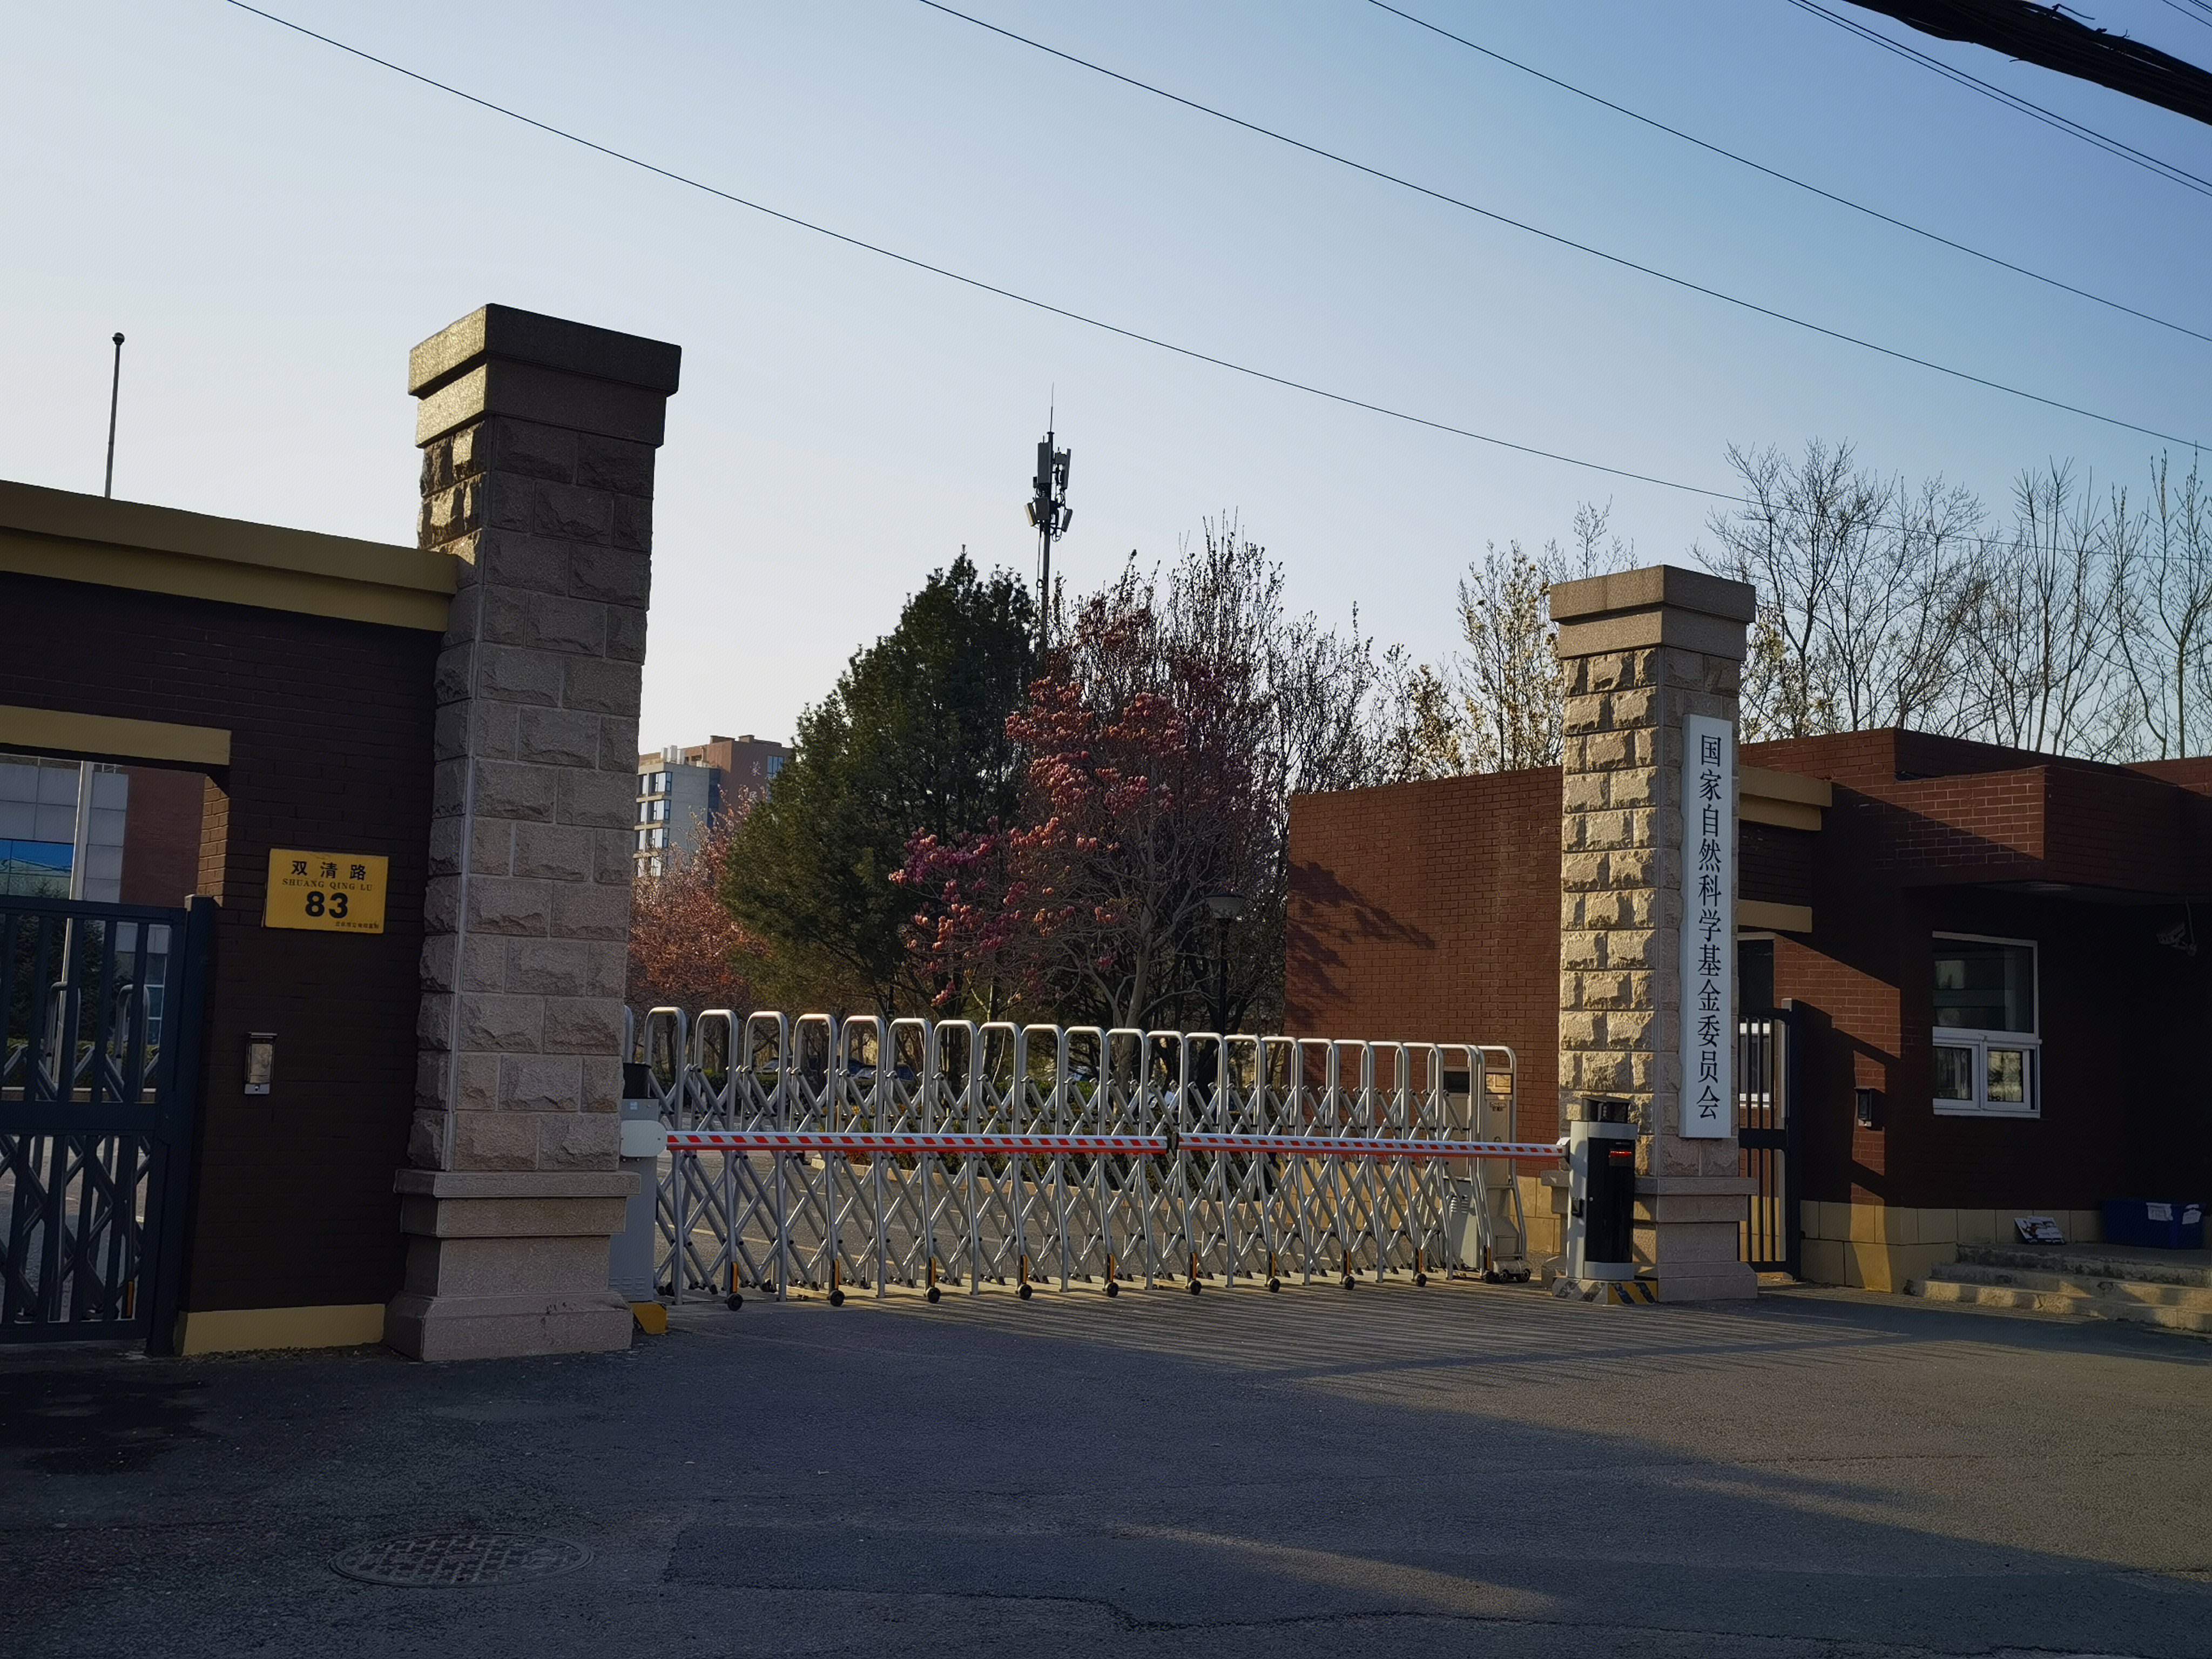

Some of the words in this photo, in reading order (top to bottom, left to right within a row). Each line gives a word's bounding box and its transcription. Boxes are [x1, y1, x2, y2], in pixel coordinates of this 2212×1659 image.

[292, 861, 366, 880] 双清路
[282, 879, 324, 887] SHUANG
[330, 882, 355, 890] QING
[306, 891, 348, 918] 83
[1697, 734, 1722, 1119] 国家自然科学基金委员会
